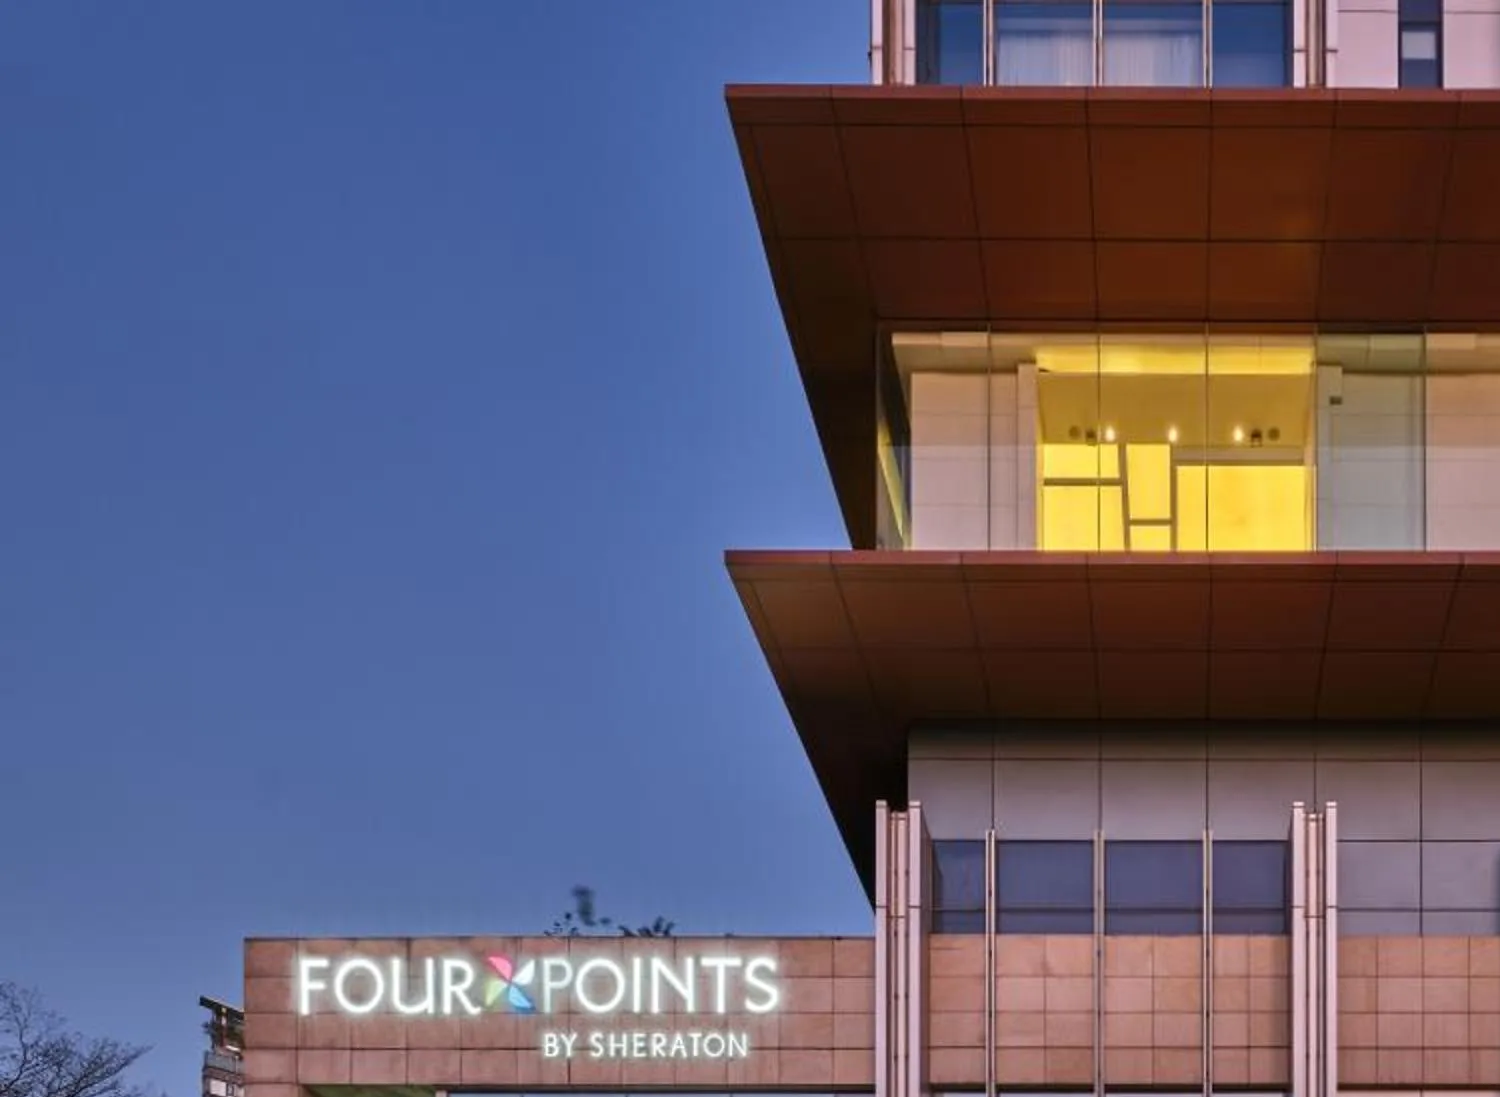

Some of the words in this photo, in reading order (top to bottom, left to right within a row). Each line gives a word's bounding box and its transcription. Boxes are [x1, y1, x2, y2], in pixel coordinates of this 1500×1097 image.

[299, 957, 481, 1015] FOUR
[543, 956, 780, 1014] POINTS
[543, 1032, 577, 1058] BY
[590, 1032, 748, 1058] SHERATON
